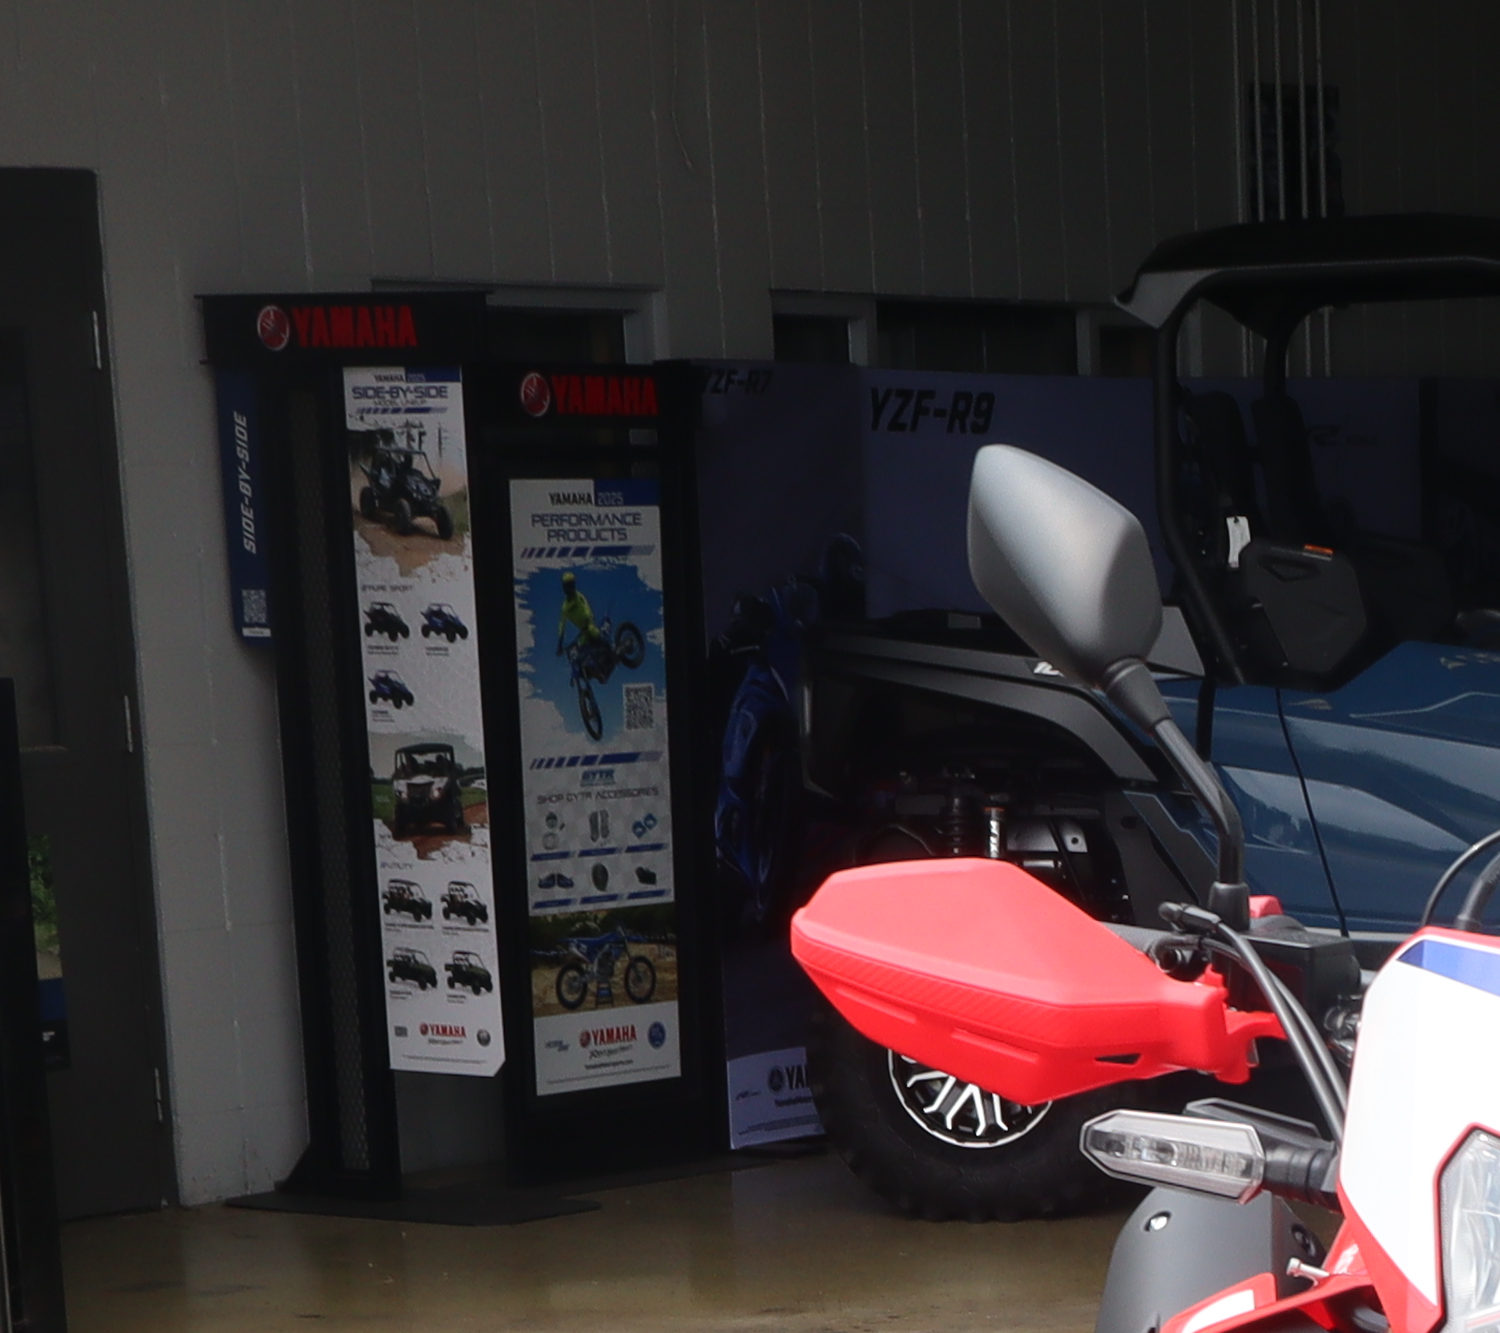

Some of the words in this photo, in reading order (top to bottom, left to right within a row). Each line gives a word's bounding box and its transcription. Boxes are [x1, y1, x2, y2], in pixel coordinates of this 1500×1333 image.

[291, 305, 418, 348] YAMAHA
[352, 385, 449, 400] SIDE-BY-SIDE
[551, 375, 660, 417] YAMAHA
[870, 388, 996, 435] YZF-R9
[235, 411, 258, 554] SIDE-BY-SIDE
[548, 491, 593, 507] YAMAHA
[597, 491, 624, 506] 2025
[531, 512, 643, 528] PERFORMANCE
[547, 527, 628, 543] PRODUCTS
[429, 1023, 467, 1039] YAMAHA
[592, 1024, 638, 1047] YAMAHA
